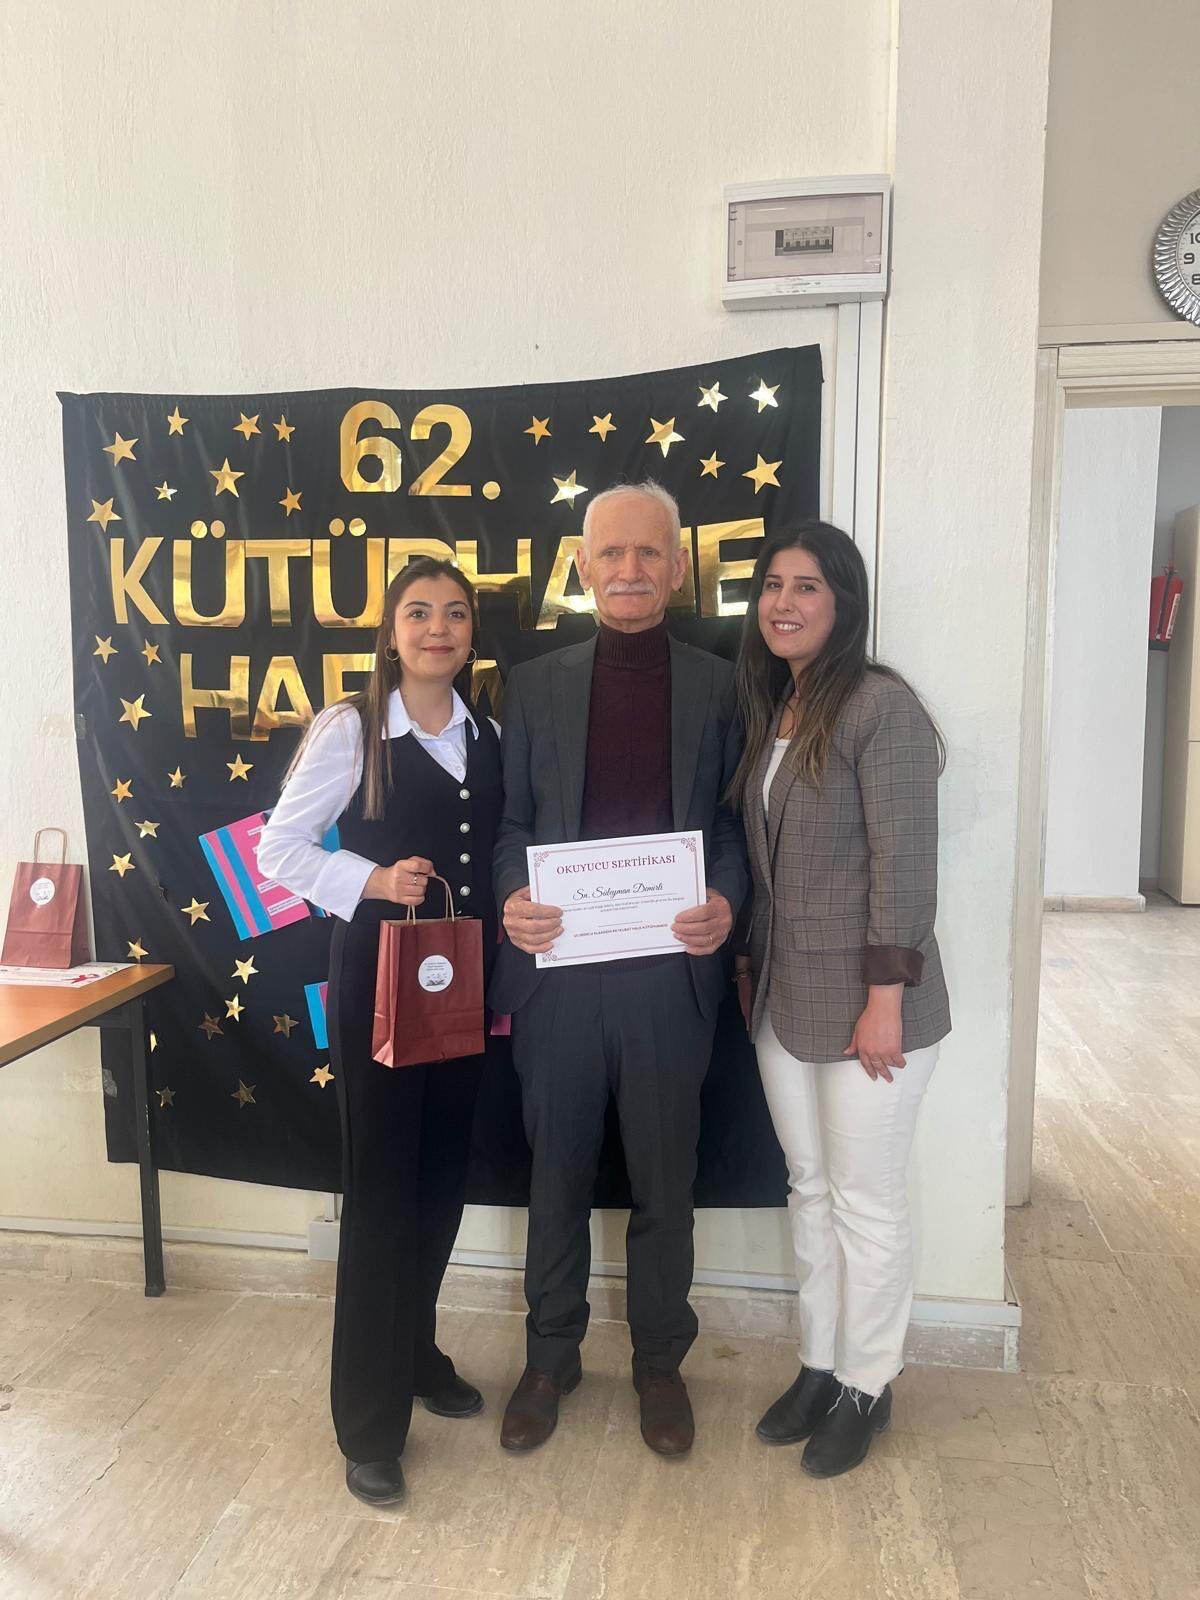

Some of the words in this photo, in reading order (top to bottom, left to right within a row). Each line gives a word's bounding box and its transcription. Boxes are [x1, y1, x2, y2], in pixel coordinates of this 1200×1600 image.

[1183, 252, 1195, 265] 9
[1191, 273, 1200, 285] 8
[339, 400, 502, 500] 62.
[556, 861, 609, 875] OKUYUCU
[611, 854, 676, 869] SERTİFİKASI
[572, 888, 590, 900] Sn.
